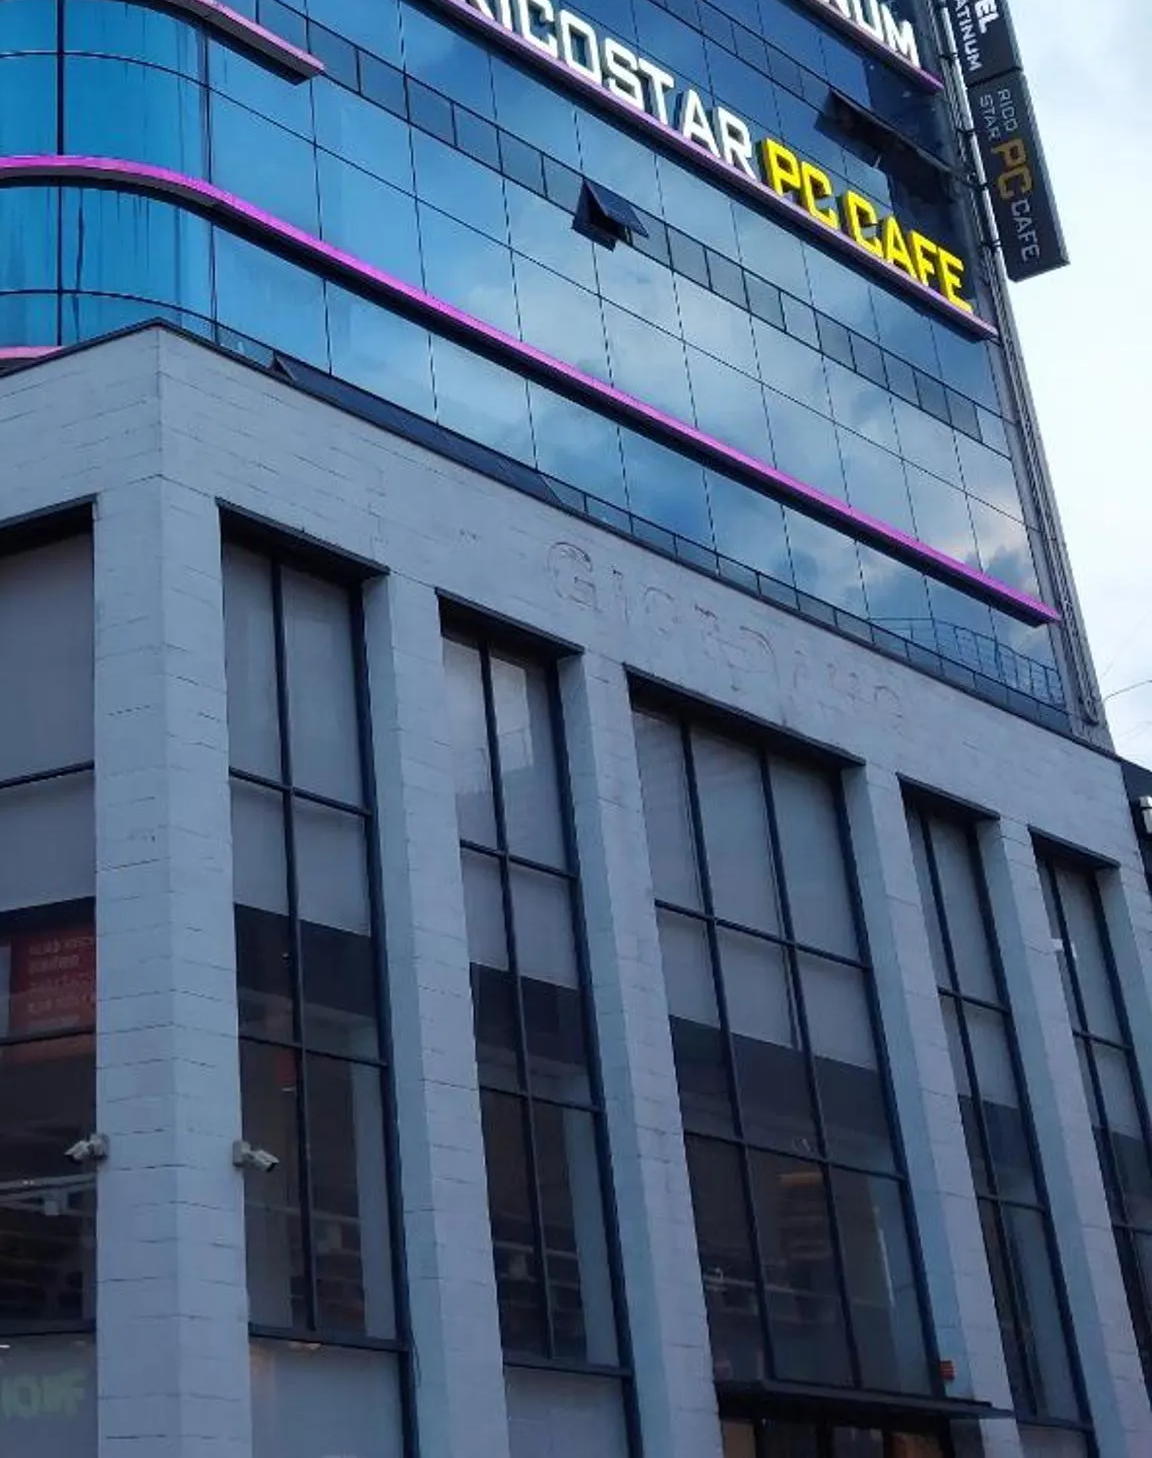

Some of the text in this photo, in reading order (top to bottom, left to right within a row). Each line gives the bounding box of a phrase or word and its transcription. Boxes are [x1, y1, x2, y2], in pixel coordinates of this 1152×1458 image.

[979, 93, 1002, 141] STAR
[990, 138, 1033, 199] PC
[759, 137, 838, 229] PC
[841, 190, 973, 312] CAFE
[1010, 197, 1040, 262] CAFE
